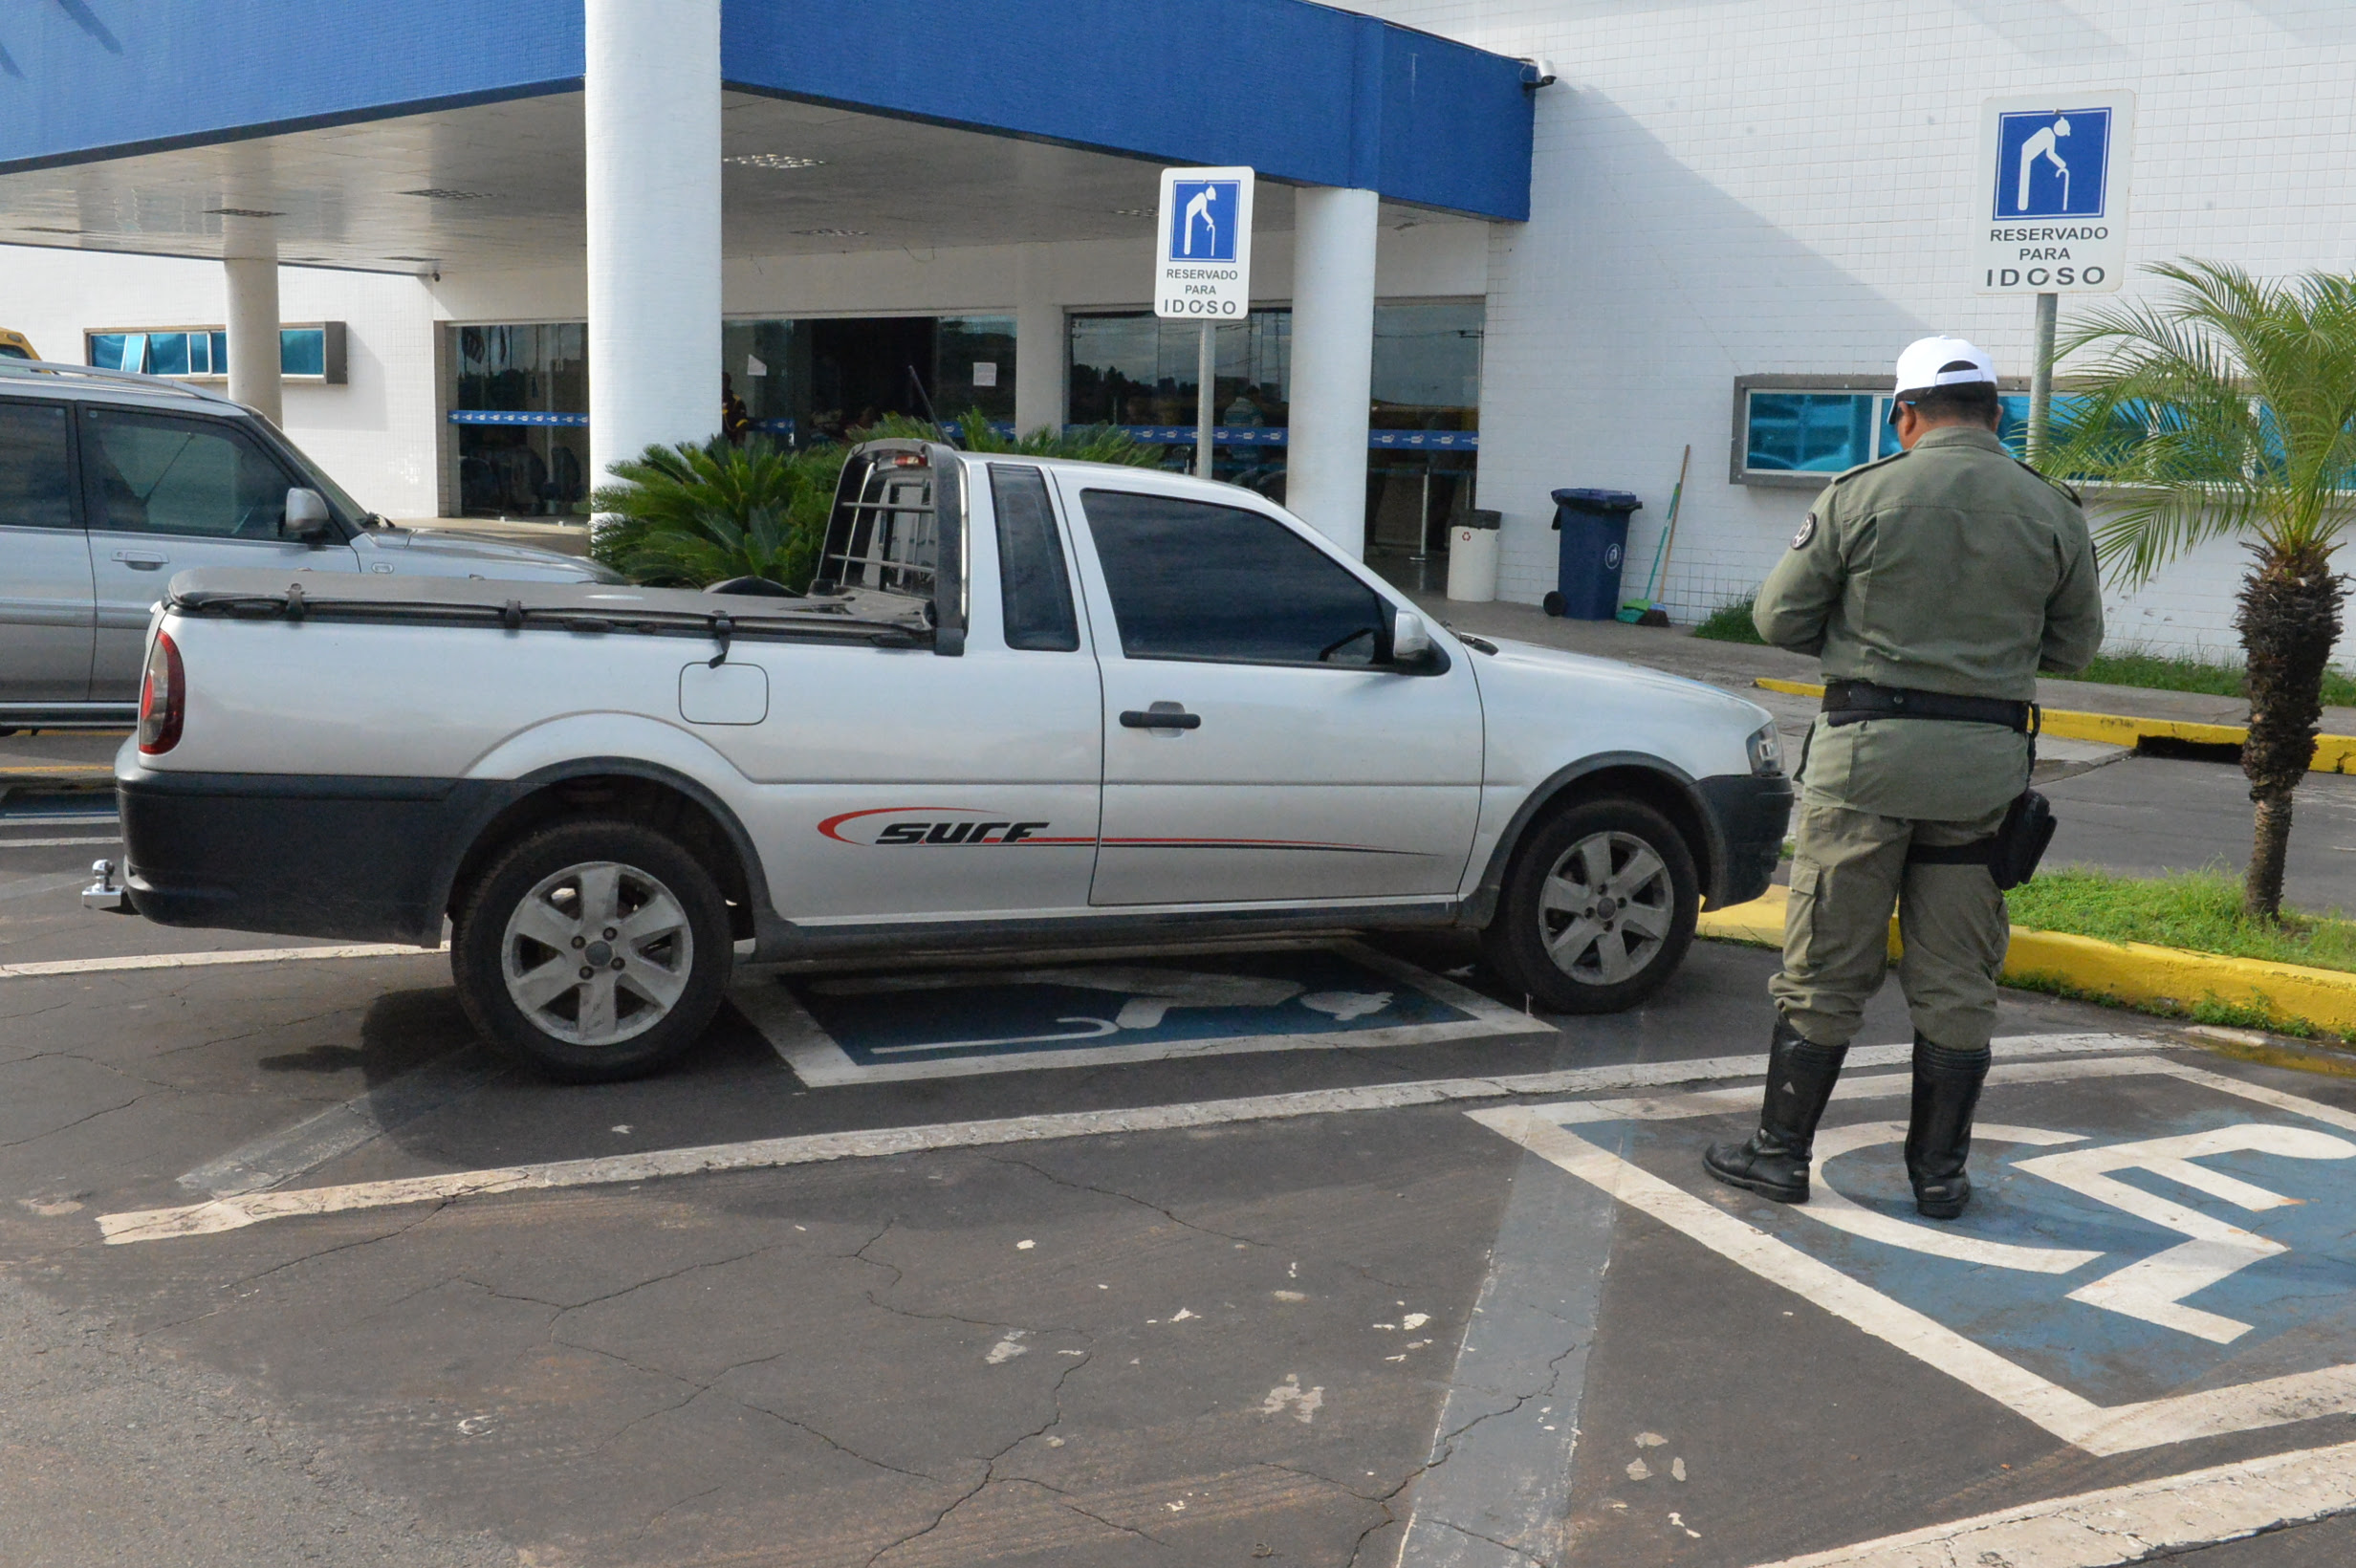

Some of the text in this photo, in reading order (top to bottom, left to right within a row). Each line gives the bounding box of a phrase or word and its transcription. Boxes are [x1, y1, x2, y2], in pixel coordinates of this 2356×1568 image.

[1990, 227, 2108, 242] RESERVADO
[2019, 248, 2071, 260] PARA
[1167, 269, 1238, 280] RESERVADO
[1986, 266, 2105, 287] IDOSO
[1185, 285, 1216, 294] PARA
[1165, 299, 1236, 315] IDOSO
